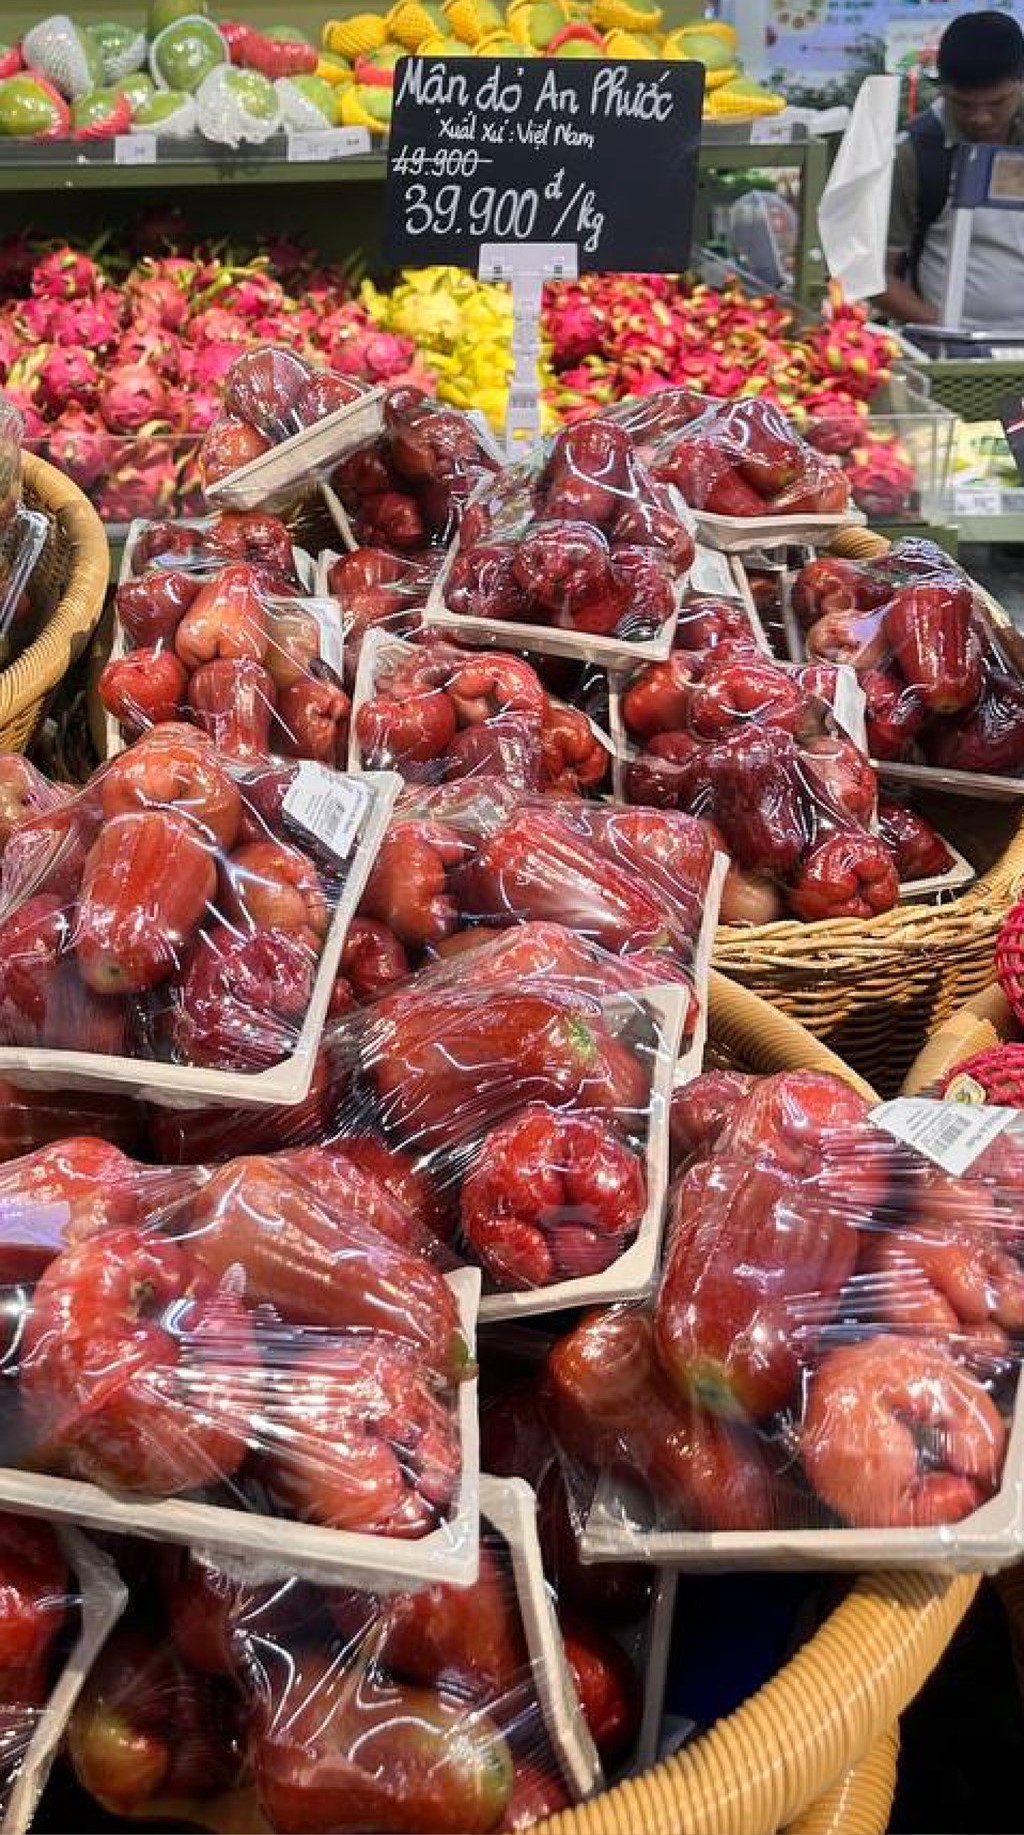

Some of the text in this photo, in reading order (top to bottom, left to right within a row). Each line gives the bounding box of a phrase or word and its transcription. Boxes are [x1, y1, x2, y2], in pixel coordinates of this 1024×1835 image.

[395, 57, 675, 121] Mận đỏ An Phước
[553, 122, 596, 149] Nam
